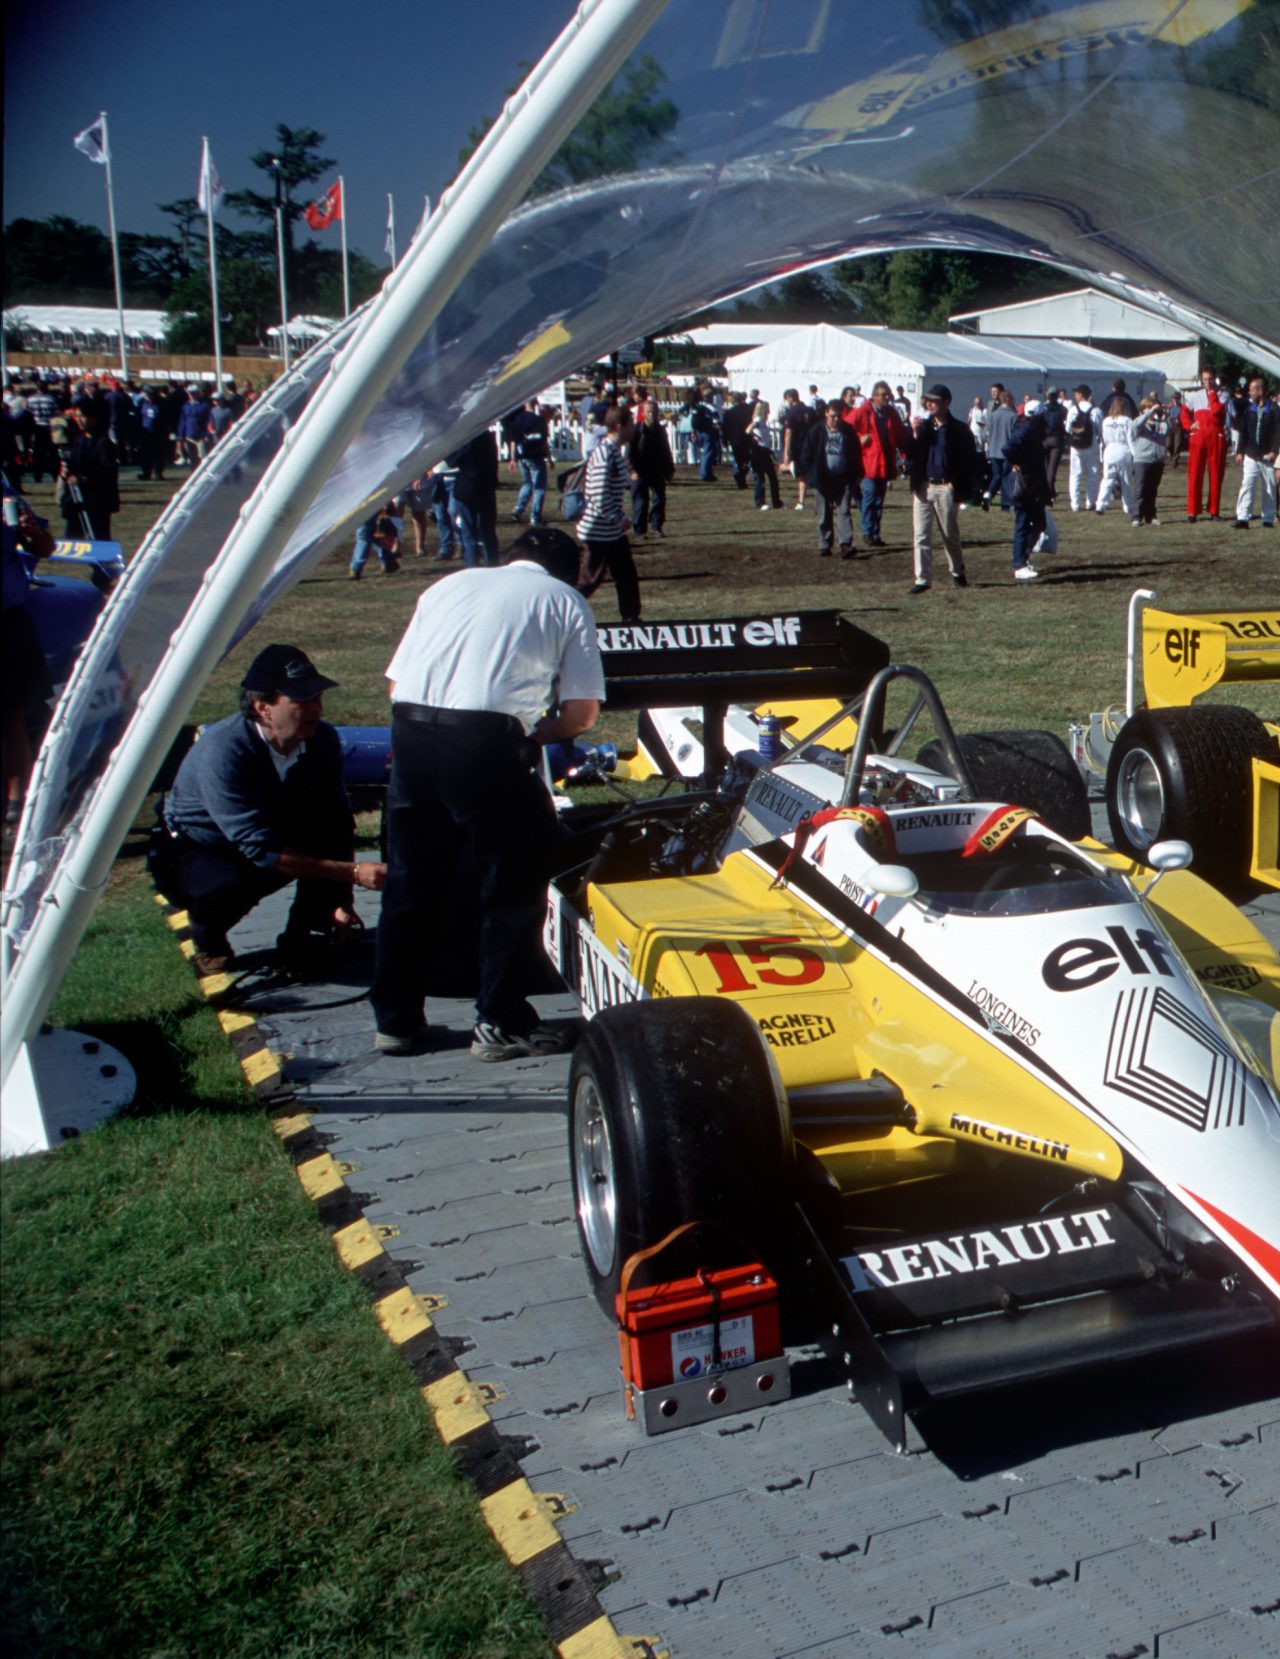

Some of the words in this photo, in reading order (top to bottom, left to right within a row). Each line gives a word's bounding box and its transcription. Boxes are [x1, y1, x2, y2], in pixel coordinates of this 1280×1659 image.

[596, 623, 736, 652] RENAULT
[743, 617, 801, 646] elf
[1165, 627, 1200, 668] elf
[757, 784, 803, 823] RENAULT
[896, 812, 976, 832] RENAULT
[982, 810, 1027, 847] Sabel
[840, 873, 866, 907] PROST
[694, 936, 826, 994] 15
[1041, 925, 1176, 993] elf
[759, 1013, 836, 1035] AGNETI
[966, 979, 1042, 1048] LONGINES
[766, 1021, 836, 1047] ARELLI
[950, 1112, 1070, 1162] MICHELIN
[838, 1208, 1116, 1294] RENAULT
[703, 1346, 747, 1365] HWKER
